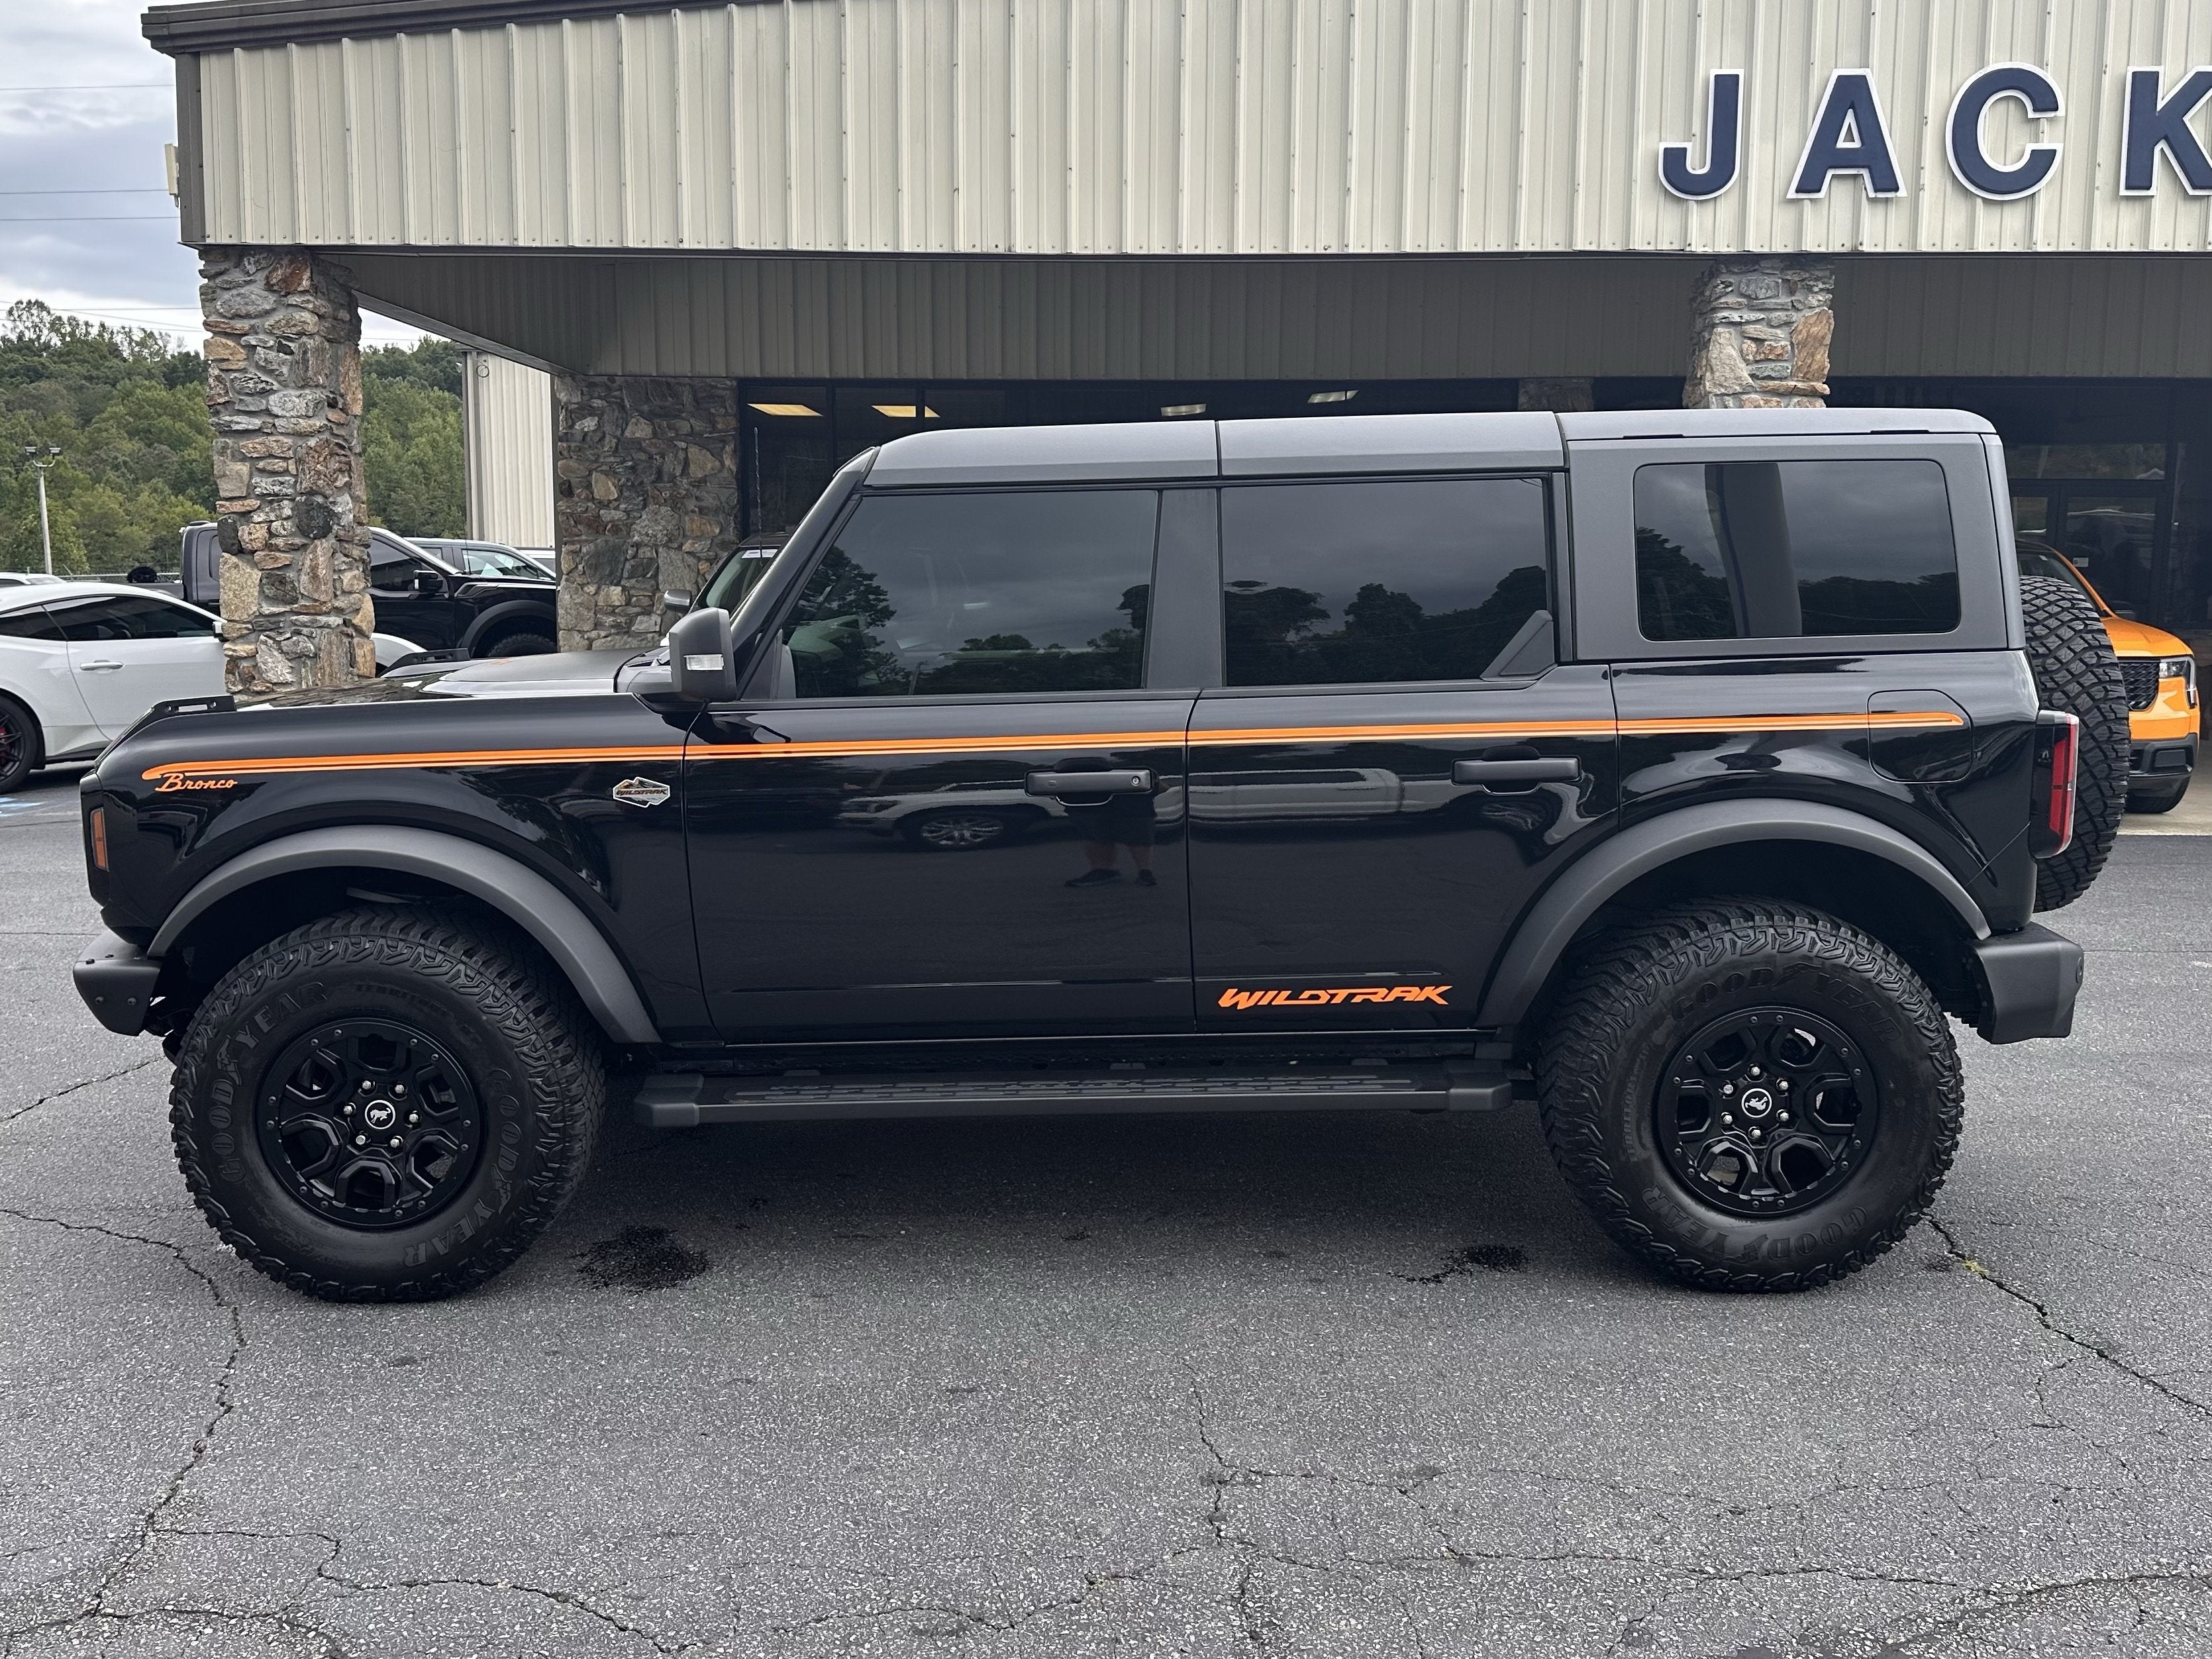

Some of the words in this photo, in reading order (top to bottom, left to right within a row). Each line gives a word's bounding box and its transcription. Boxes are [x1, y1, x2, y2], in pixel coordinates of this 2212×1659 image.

[1658, 61, 2212, 201] JACK
[154, 772, 238, 793] Bronco
[615, 788, 668, 797] WILDTRAK
[1217, 985, 1453, 1011] WILDTRAK
